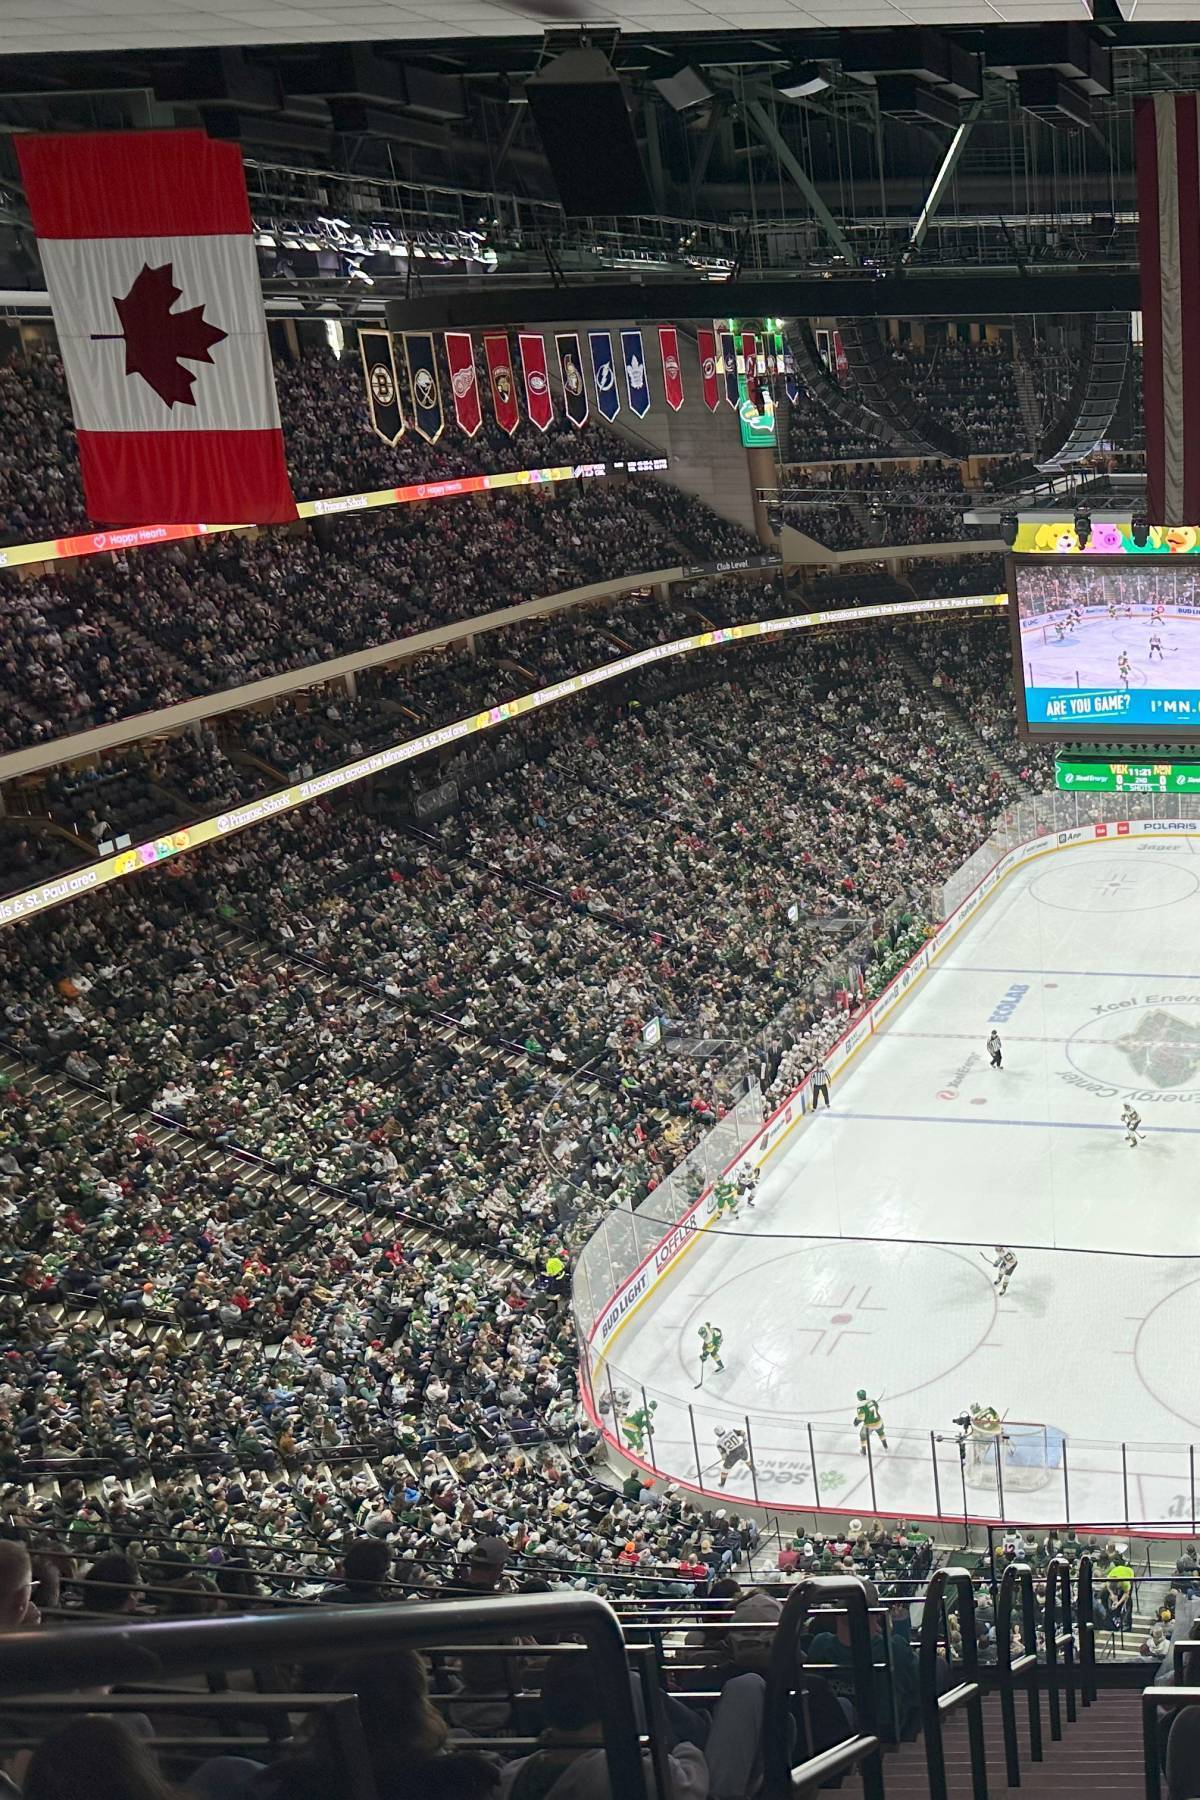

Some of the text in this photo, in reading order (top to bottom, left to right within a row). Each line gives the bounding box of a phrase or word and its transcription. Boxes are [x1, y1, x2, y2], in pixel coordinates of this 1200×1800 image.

[110, 528, 167, 547] Happy Hearts
[1046, 694, 1131, 717] ARE YOU GAME?
[309, 772, 345, 794] locations
[345, 763, 370, 779] across
[369, 757, 383, 769] the
[382, 741, 423, 766] Minneapolis
[438, 729, 453, 744] Paul
[452, 724, 468, 738] area
[229, 793, 290, 827] Primrose Schools
[14, 902, 23, 912] &
[25, 895, 42, 908] St.
[43, 882, 68, 901] Paul
[69, 872, 97, 889] area
[986, 984, 1030, 1023] ECOLAB
[1089, 997, 1138, 1016] Xcel
[1054, 1070, 1119, 1099] Center
[655, 1214, 698, 1269] LOFFLER
[602, 1274, 648, 1339] BUD LIGHT
[724, 1435, 740, 1450] 20
